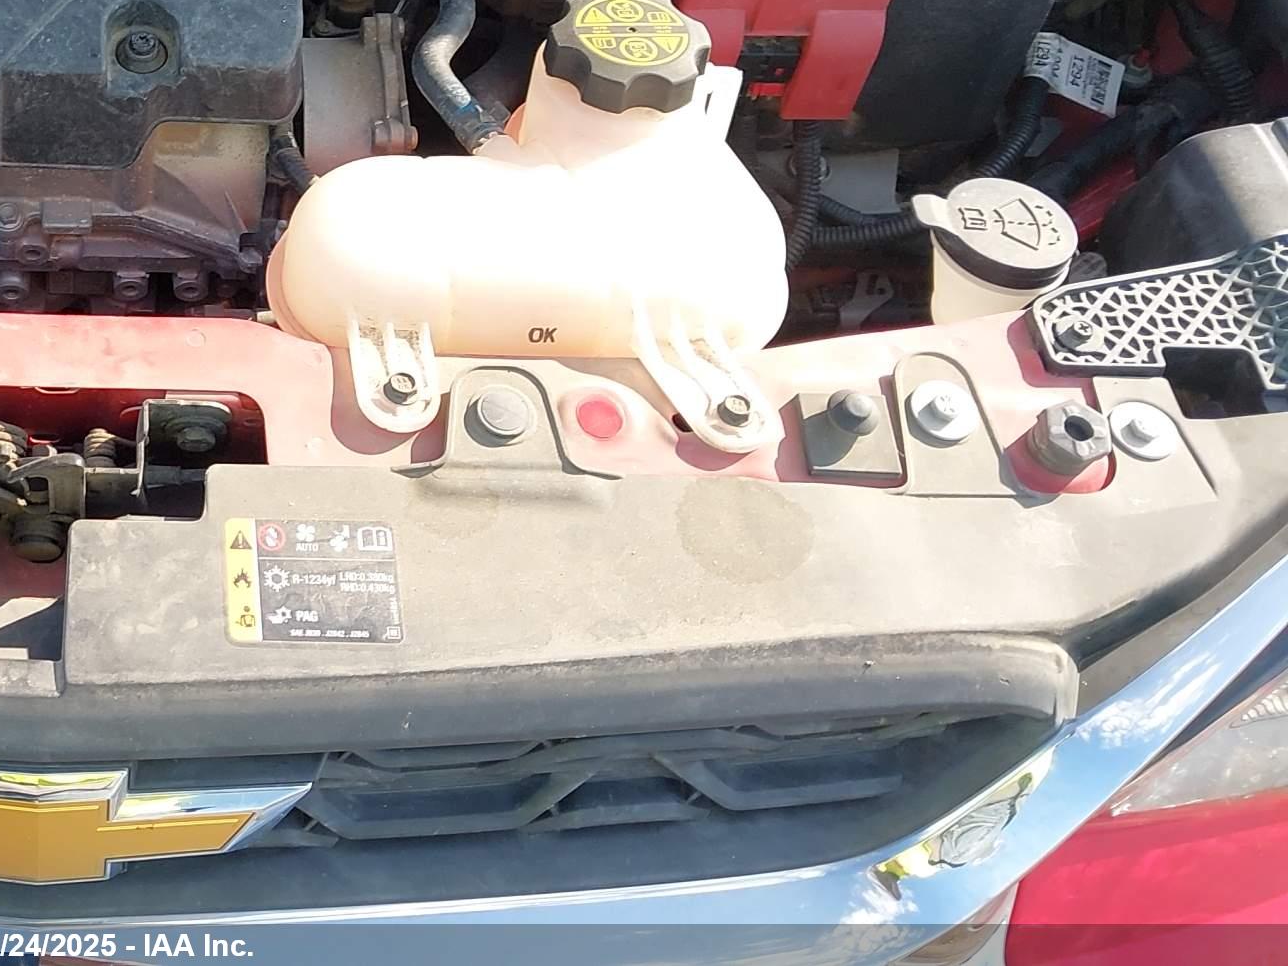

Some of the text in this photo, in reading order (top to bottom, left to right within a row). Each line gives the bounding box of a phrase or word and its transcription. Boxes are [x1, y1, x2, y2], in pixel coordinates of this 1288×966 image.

[528, 327, 558, 343] OK
[295, 543, 319, 552] AUTO
[295, 610, 319, 623] PAG
